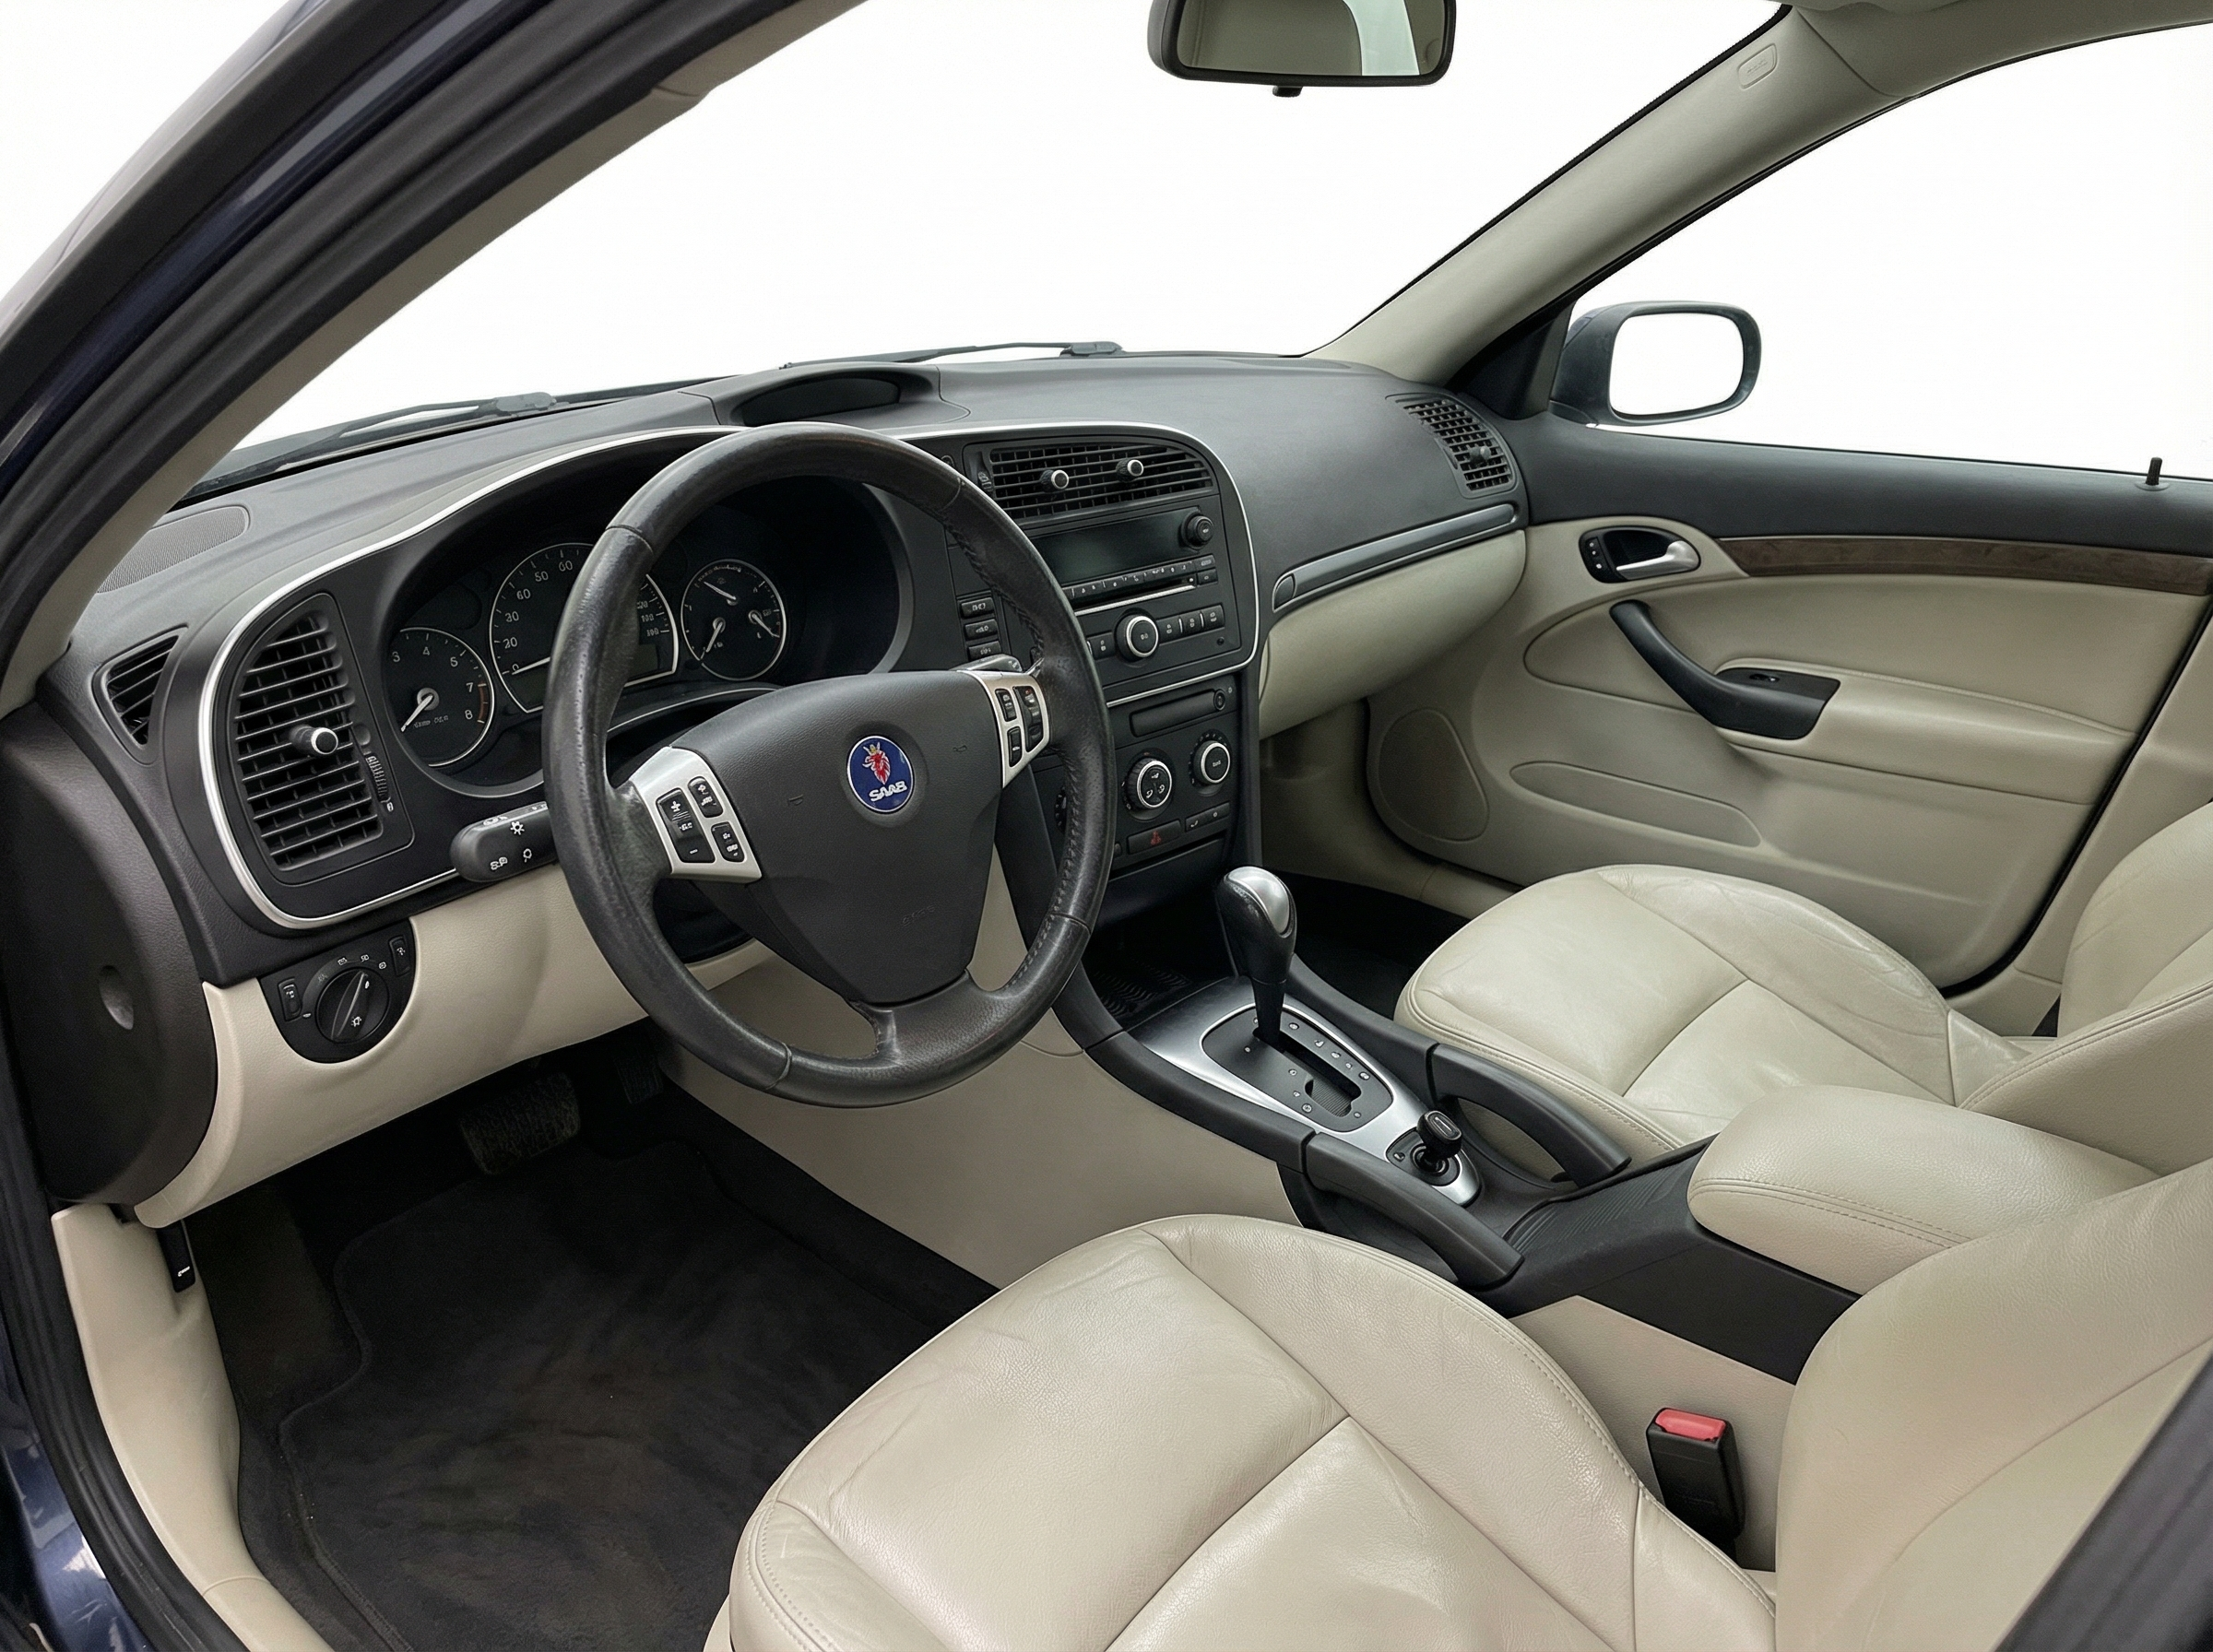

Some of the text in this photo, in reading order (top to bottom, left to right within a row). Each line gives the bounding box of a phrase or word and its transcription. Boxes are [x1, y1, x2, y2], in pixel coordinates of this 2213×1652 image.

[535, 571, 549, 583] 50
[503, 637, 518, 649] 20
[391, 651, 401, 663] 3
[422, 646, 431, 656] 4
[466, 682, 474, 693] 7
[465, 709, 473, 720] 8
[869, 780, 907, 802] SAAB
